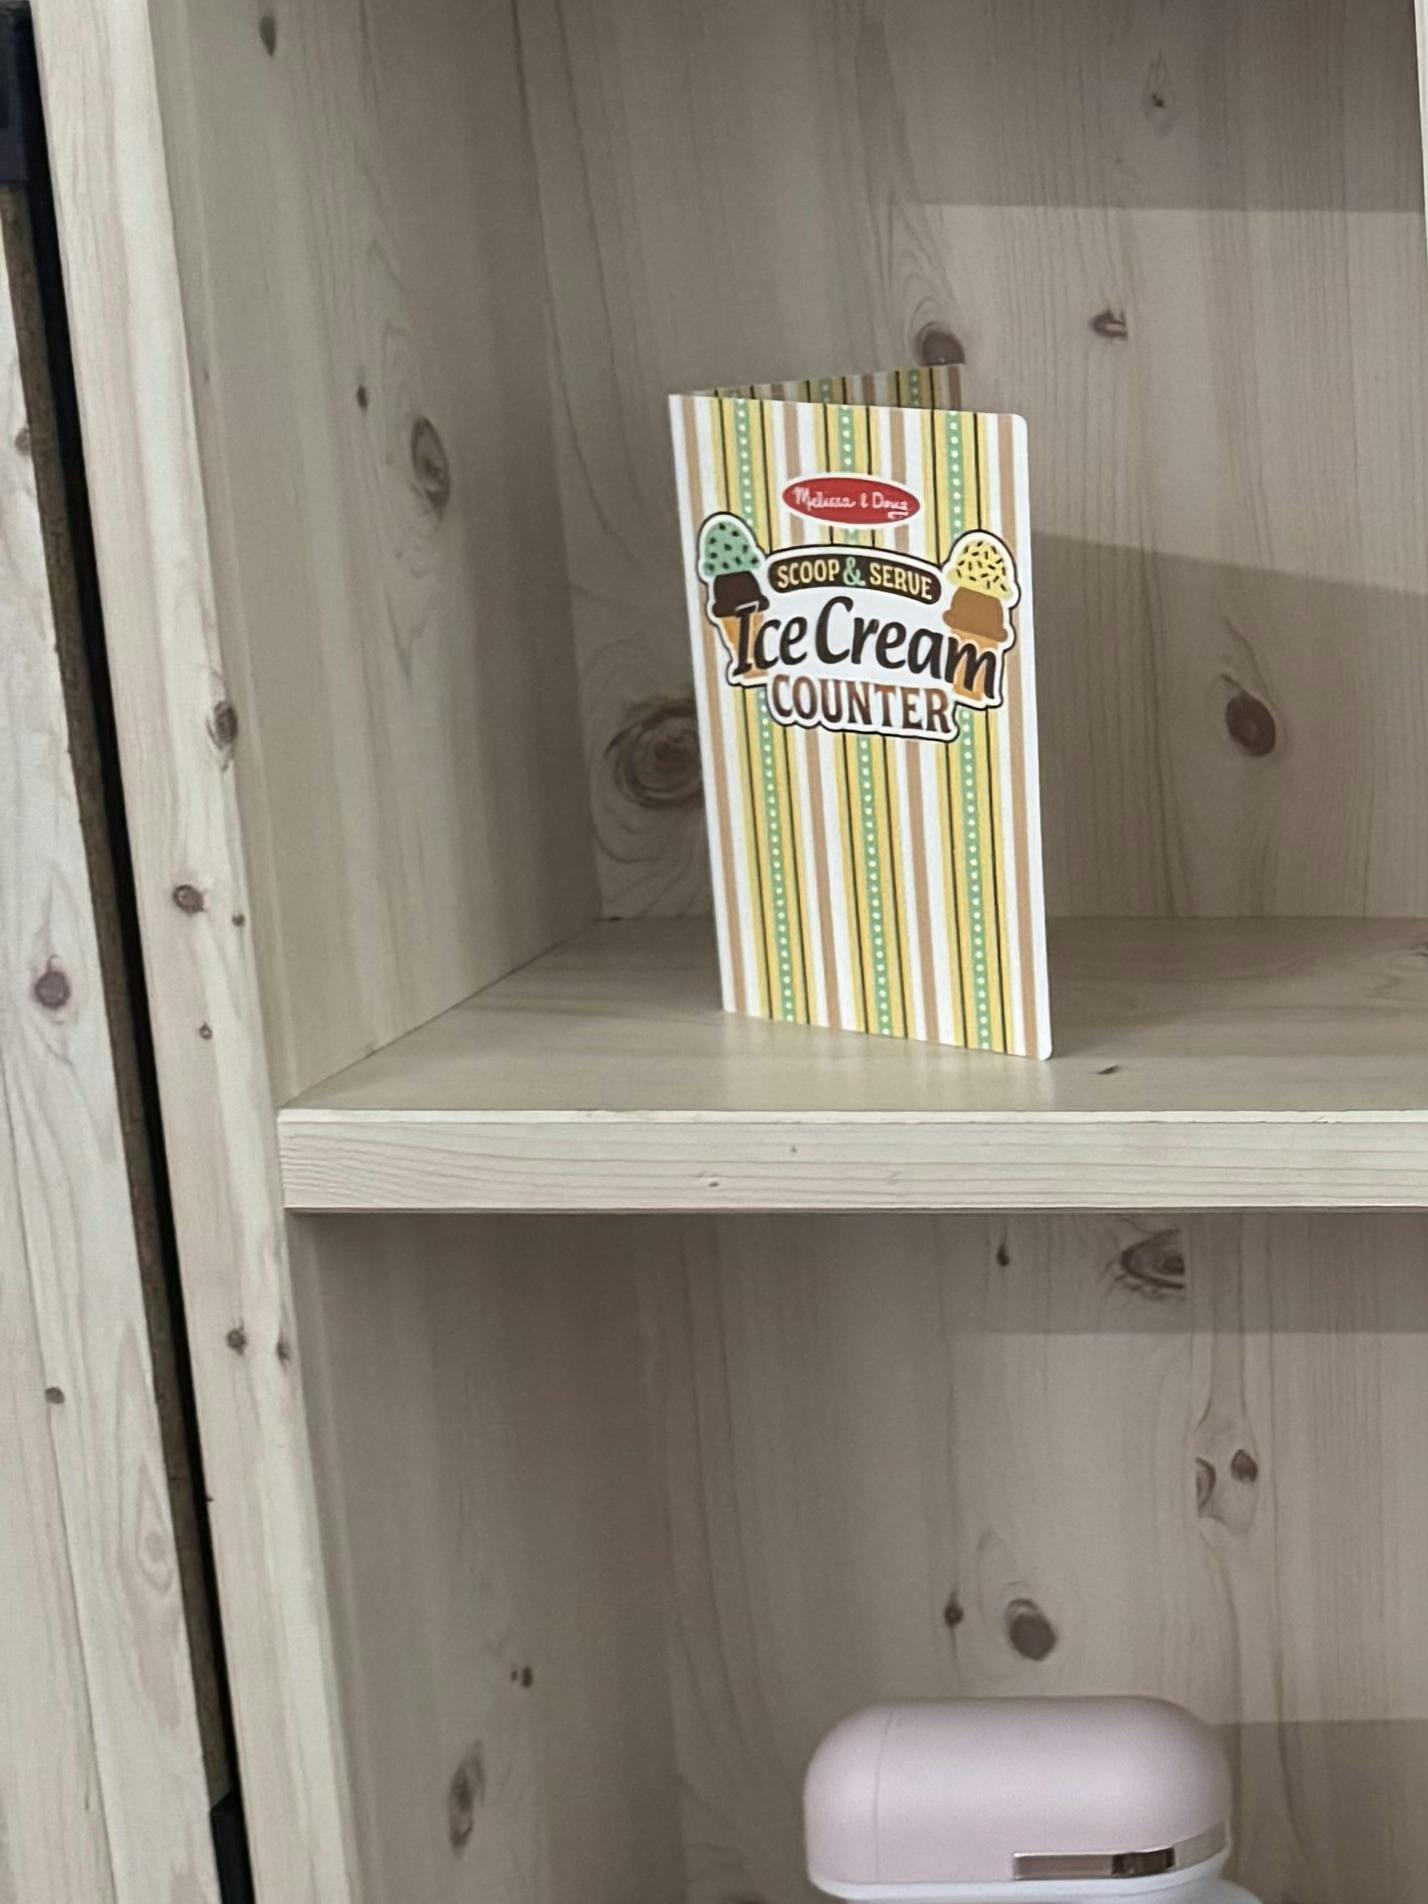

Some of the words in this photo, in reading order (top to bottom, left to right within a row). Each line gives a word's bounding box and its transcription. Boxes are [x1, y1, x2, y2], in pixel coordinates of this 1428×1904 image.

[792, 486, 856, 511] Melissa
[872, 492, 909, 519] Doug
[777, 559, 840, 589] SCOOP
[842, 556, 866, 587] &
[869, 563, 933, 601] SERVE
[733, 601, 807, 676] Ice
[815, 595, 997, 700] Cream
[772, 674, 952, 734] COUNTER
